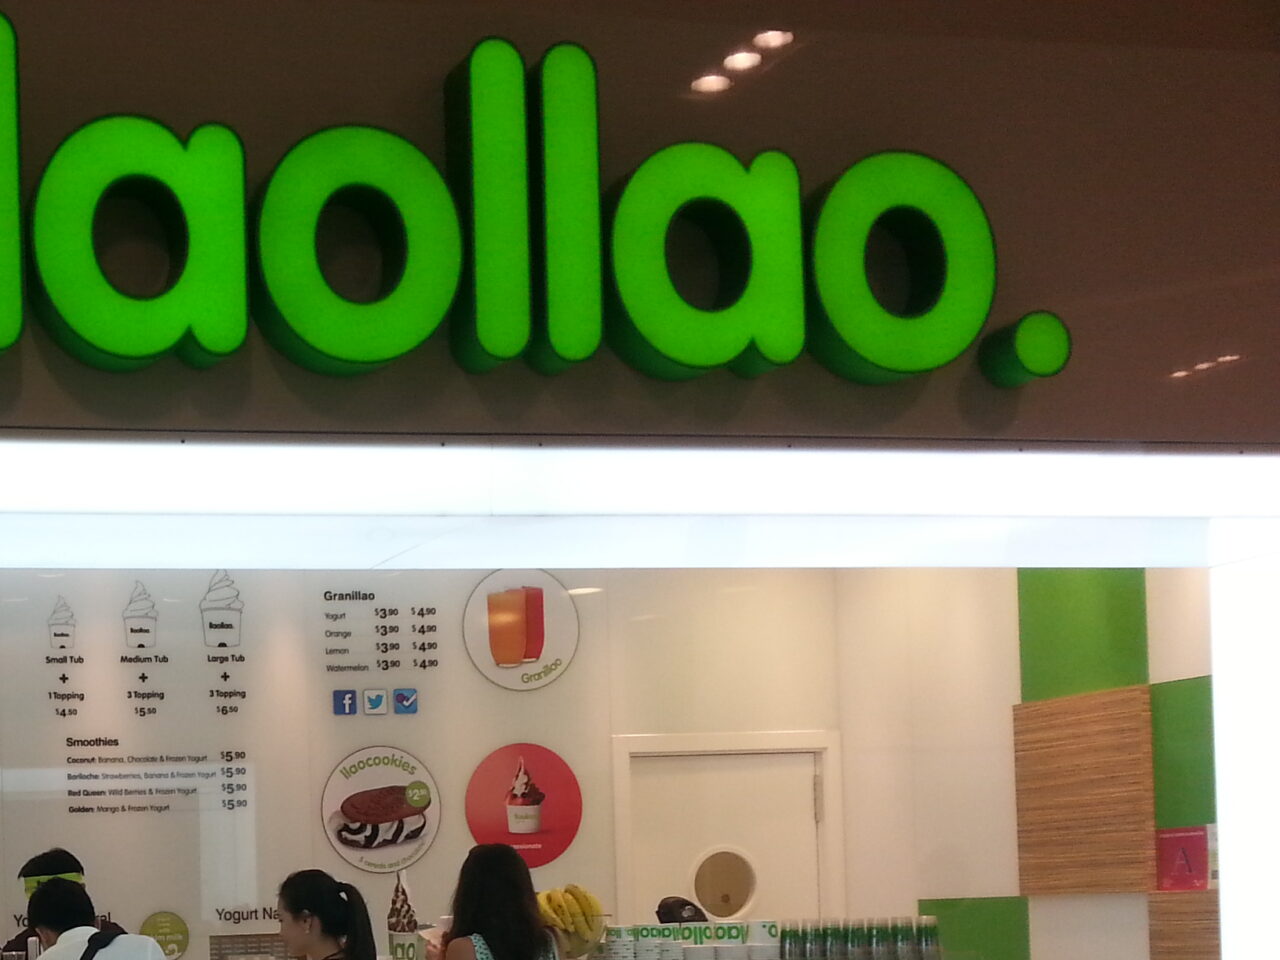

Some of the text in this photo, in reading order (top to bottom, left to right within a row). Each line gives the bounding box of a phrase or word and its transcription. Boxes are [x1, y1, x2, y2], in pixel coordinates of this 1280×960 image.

[323, 590, 376, 601] Granillao
[324, 612, 346, 621] Yogurt
[374, 607, 399, 619] $3.90
[325, 630, 352, 640] Orange
[375, 625, 400, 636] $3.90
[325, 647, 350, 655] Lemon
[375, 642, 400, 653] $3.90
[45, 655, 85, 664] Small Tub
[120, 655, 169, 664] Medium Tub
[207, 654, 246, 664] Large Tub
[326, 664, 370, 672] Watermelon
[376, 659, 401, 671] $3.90
[521, 657, 563, 685] Granillao
[53, 691, 85, 702] Topping
[127, 690, 165, 701] 3 Topping
[209, 689, 247, 699] 3 Topping
[66, 737, 119, 747] Smoothies
[126, 755, 158, 764] Chocolate
[159, 755, 165, 763] &
[165, 755, 186, 763] Frozen
[187, 754, 208, 764] Yogurt
[220, 750, 246, 763] $5.90
[220, 767, 246, 778] $5.90
[339, 753, 418, 781] llaocookies
[67, 789, 81, 797] Red
[124, 788, 147, 796] Berries
[155, 787, 176, 795] Frozen
[177, 787, 197, 796] Yogurt
[221, 783, 247, 794] $5.90
[127, 805, 149, 813] Frozen
[150, 804, 170, 813] Yogurt
[221, 799, 248, 811] $5.90
[215, 907, 259, 925] Yogurt
